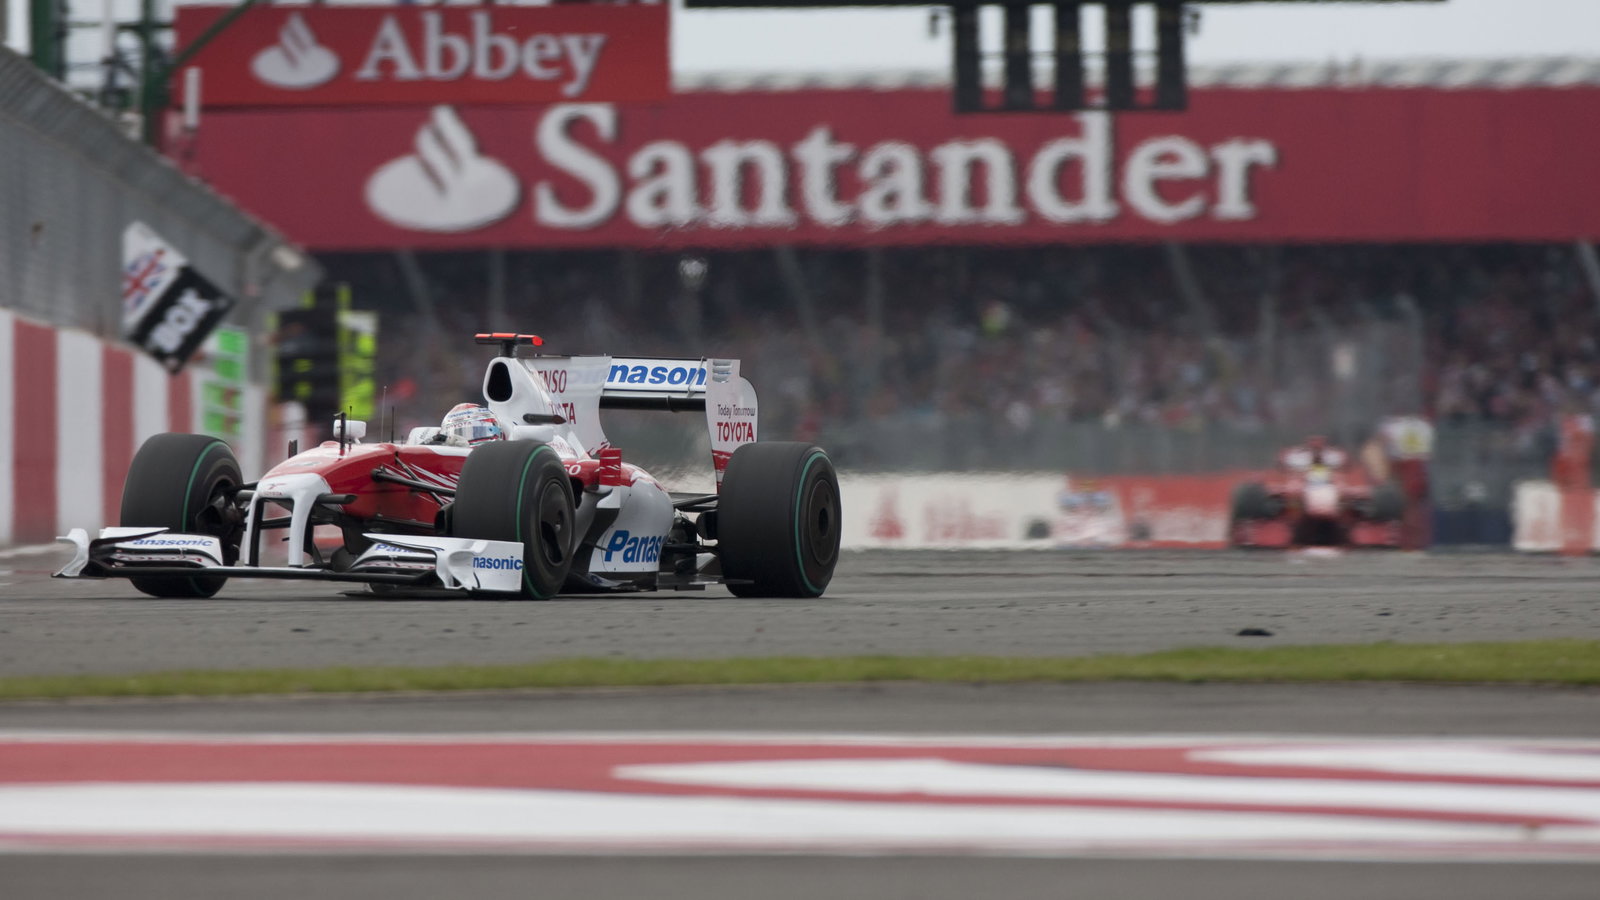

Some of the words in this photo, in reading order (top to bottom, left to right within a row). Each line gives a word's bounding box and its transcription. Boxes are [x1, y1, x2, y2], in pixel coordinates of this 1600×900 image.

[354, 12, 606, 96] Abbey
[533, 102, 1277, 230] Santander
[150, 288, 210, 352] BOX
[606, 364, 707, 386] nason
[716, 422, 755, 442] TOYOTA
[132, 538, 214, 547] anasonic
